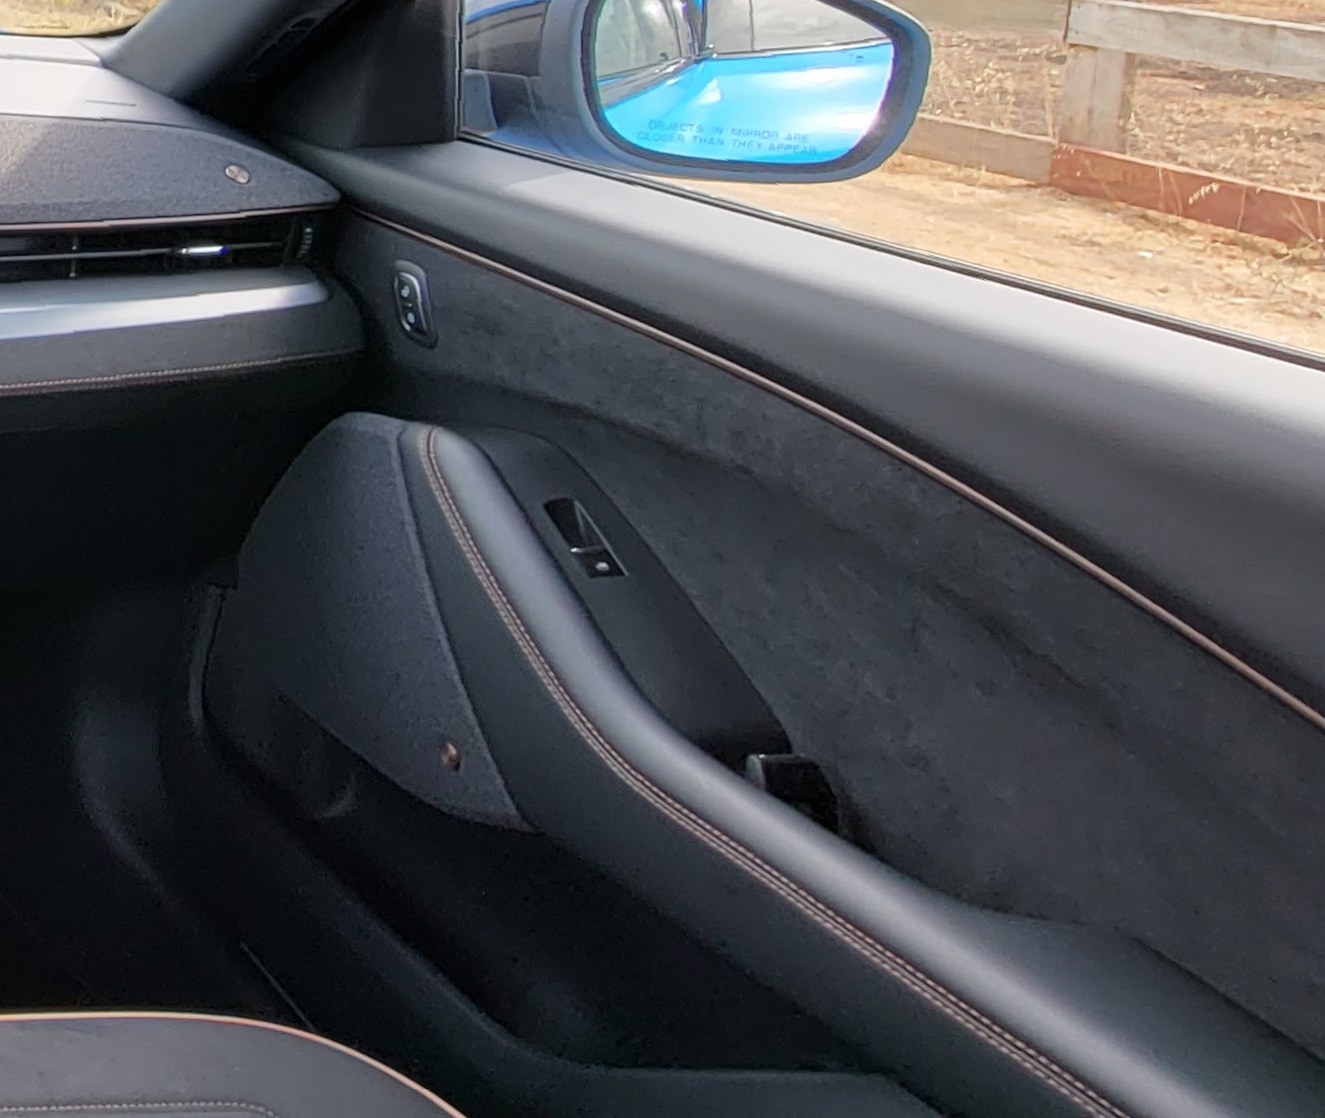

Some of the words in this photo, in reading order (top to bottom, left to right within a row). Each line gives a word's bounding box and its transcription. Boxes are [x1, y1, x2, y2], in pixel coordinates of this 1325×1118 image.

[637, 130, 686, 143] CLOSER
[692, 135, 726, 147] THAN
[732, 138, 763, 150] THEY
[768, 142, 818, 156] APPEAR
[648, 119, 705, 134] OBJECTS
[711, 125, 725, 136] IN
[730, 127, 780, 140] MIRROR
[785, 132, 811, 143] ARE
